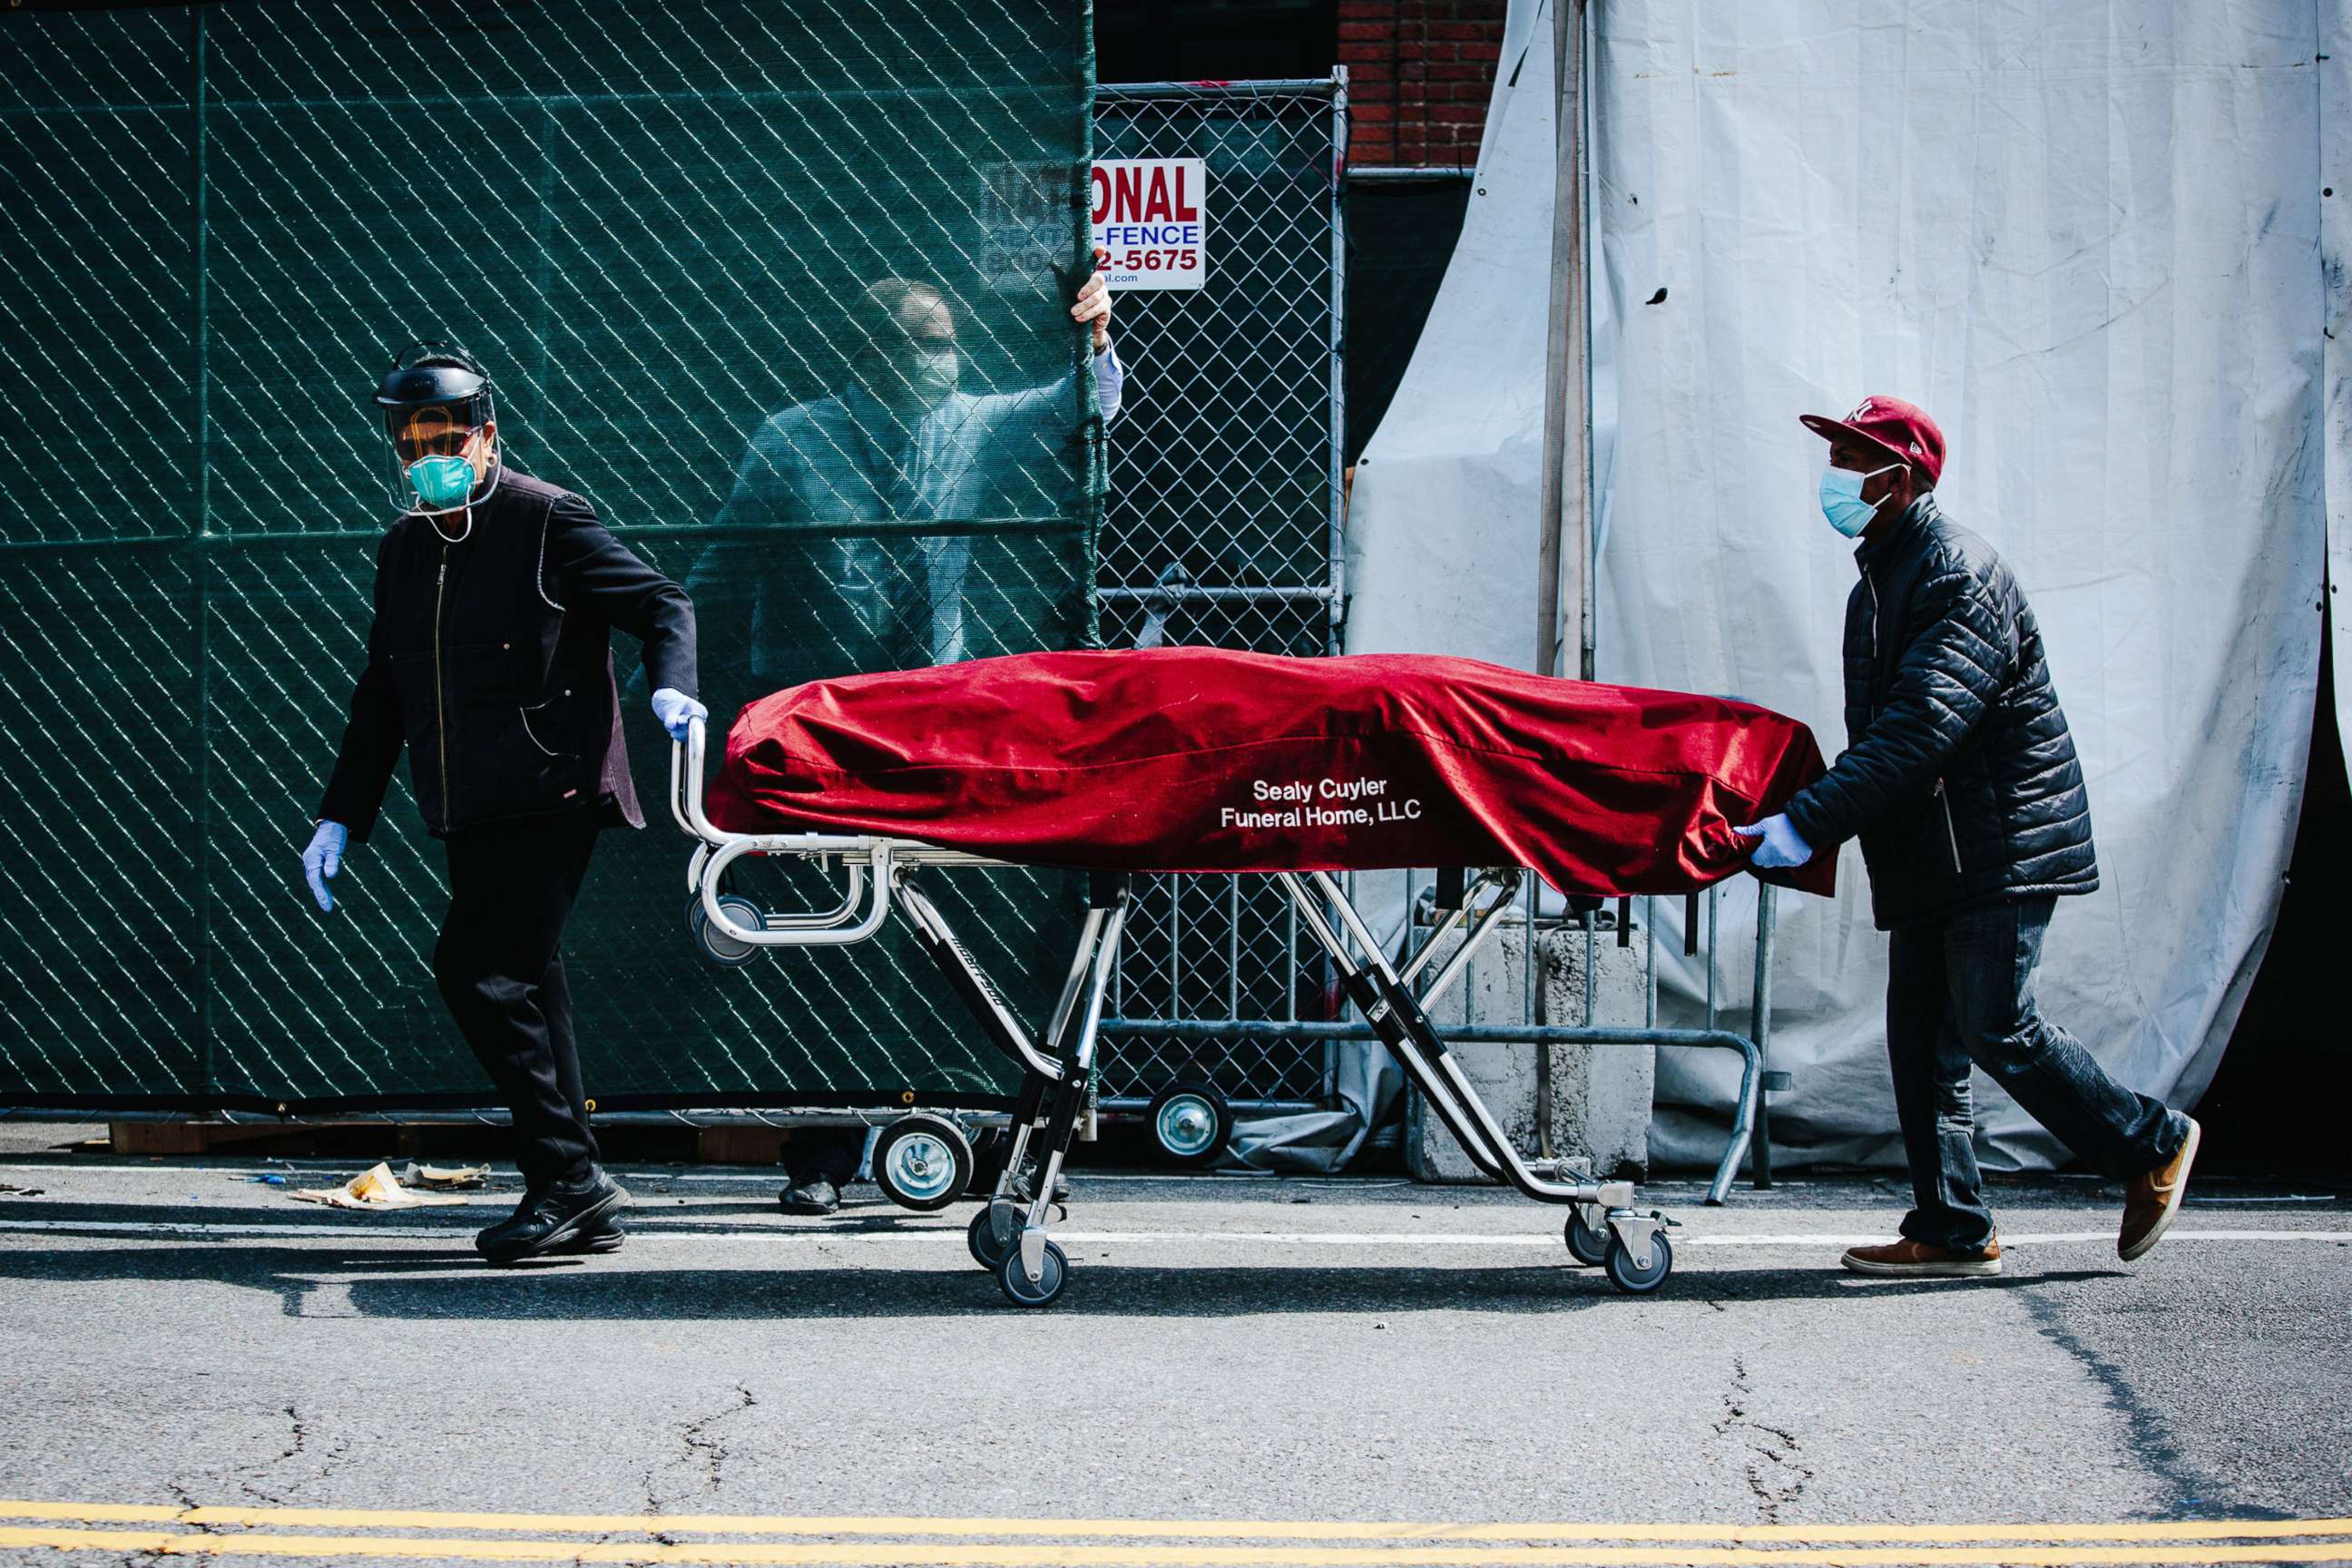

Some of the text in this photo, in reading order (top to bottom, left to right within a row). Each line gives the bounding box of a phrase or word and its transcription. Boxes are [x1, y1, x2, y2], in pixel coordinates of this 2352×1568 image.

[1253, 776, 1387, 803] Sealy Cuyler
[1220, 799, 1422, 828] Funeral Home, LLC
